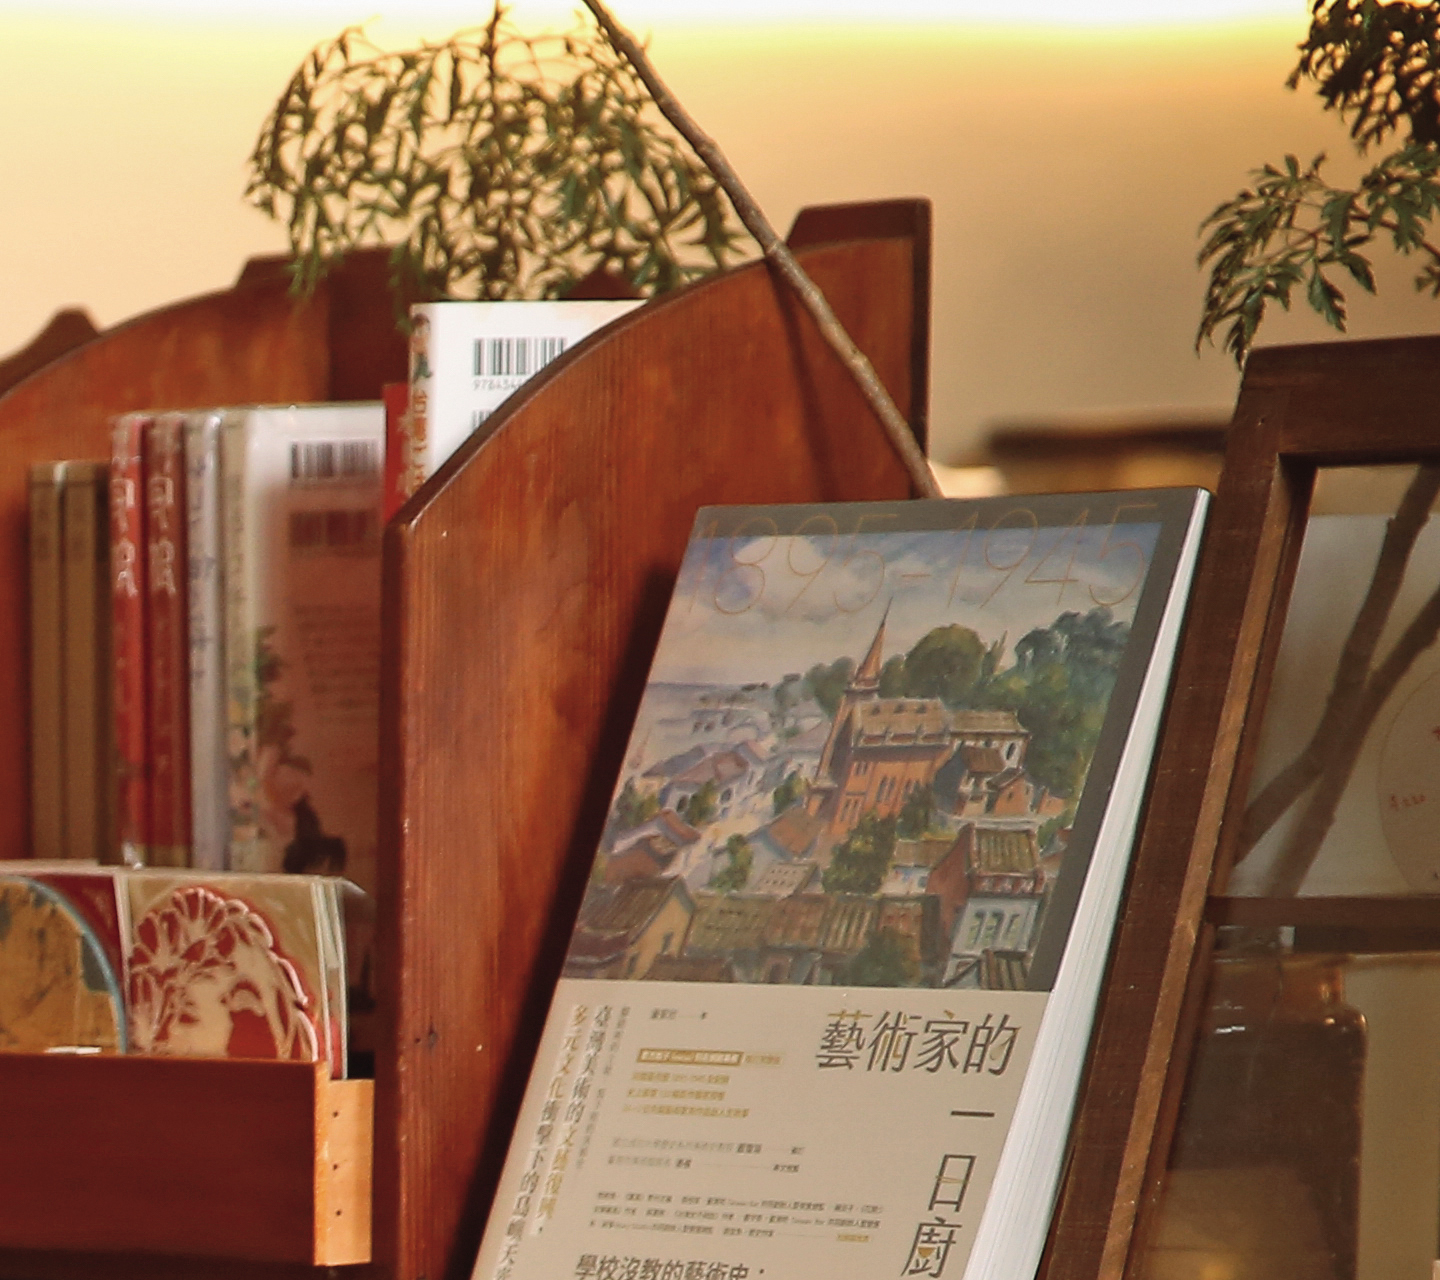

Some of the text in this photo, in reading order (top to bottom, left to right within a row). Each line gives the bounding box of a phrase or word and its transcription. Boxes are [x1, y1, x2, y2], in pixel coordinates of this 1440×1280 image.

[688, 503, 1158, 614] 1895-1945
[816, 1010, 1022, 1077] 藝術家的
